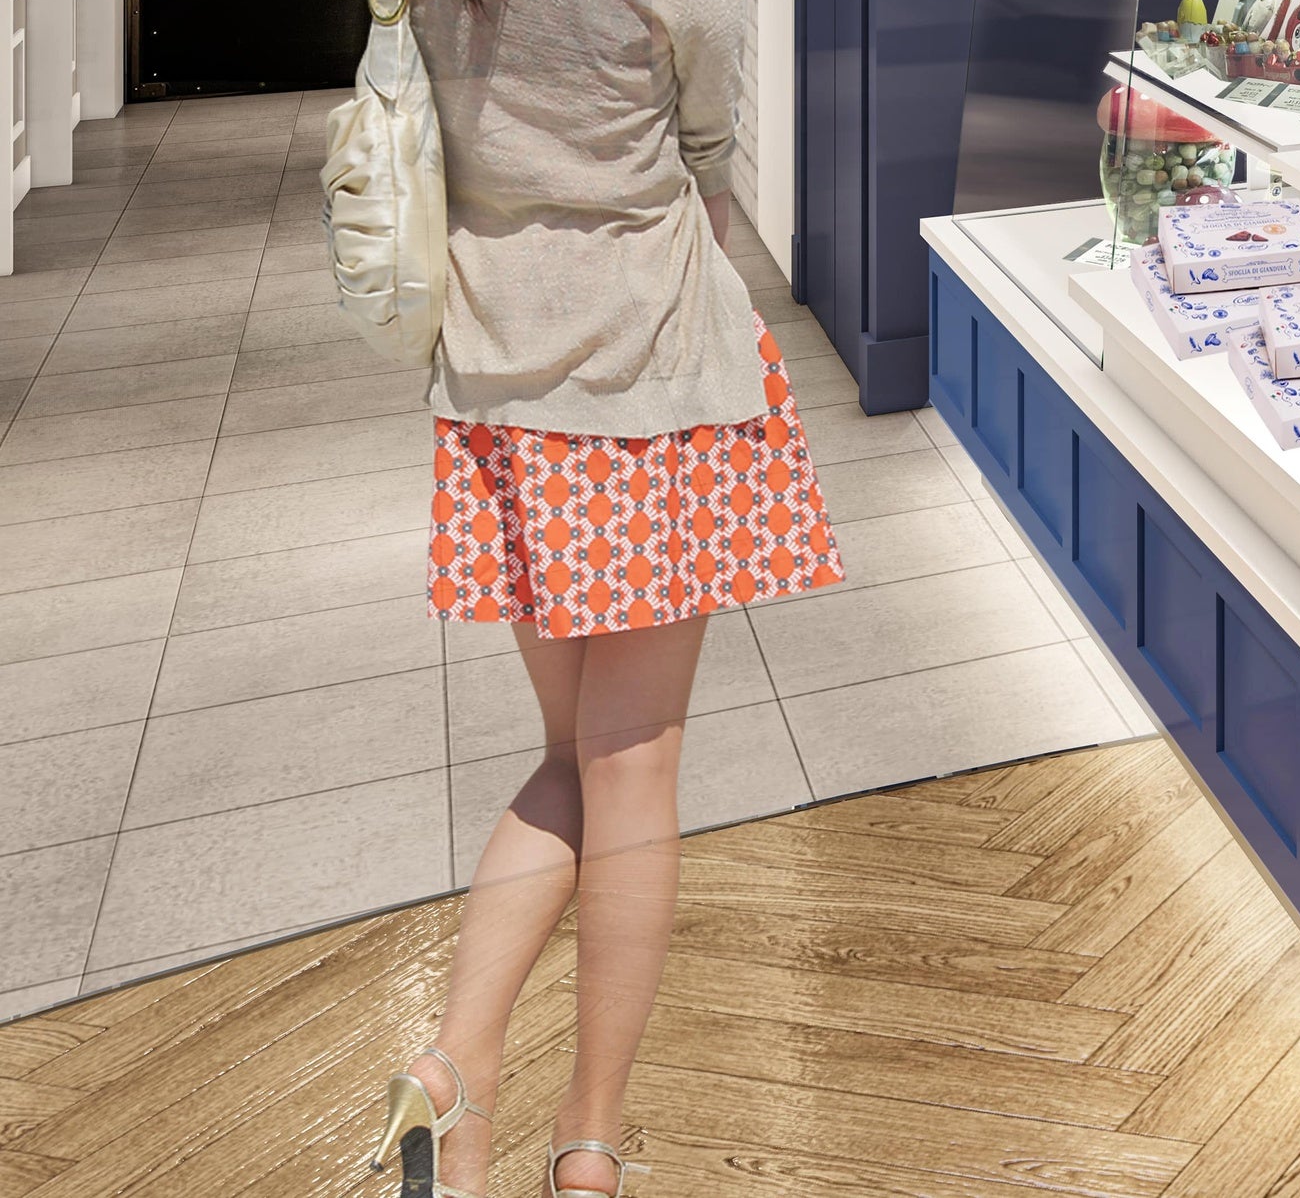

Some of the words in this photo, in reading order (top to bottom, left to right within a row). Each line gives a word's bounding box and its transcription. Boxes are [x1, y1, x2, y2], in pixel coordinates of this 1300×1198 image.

[1228, 267, 1251, 277] SFOGLIA
[1251, 266, 1259, 275] DI
[1260, 264, 1287, 275] GIANDUIA
